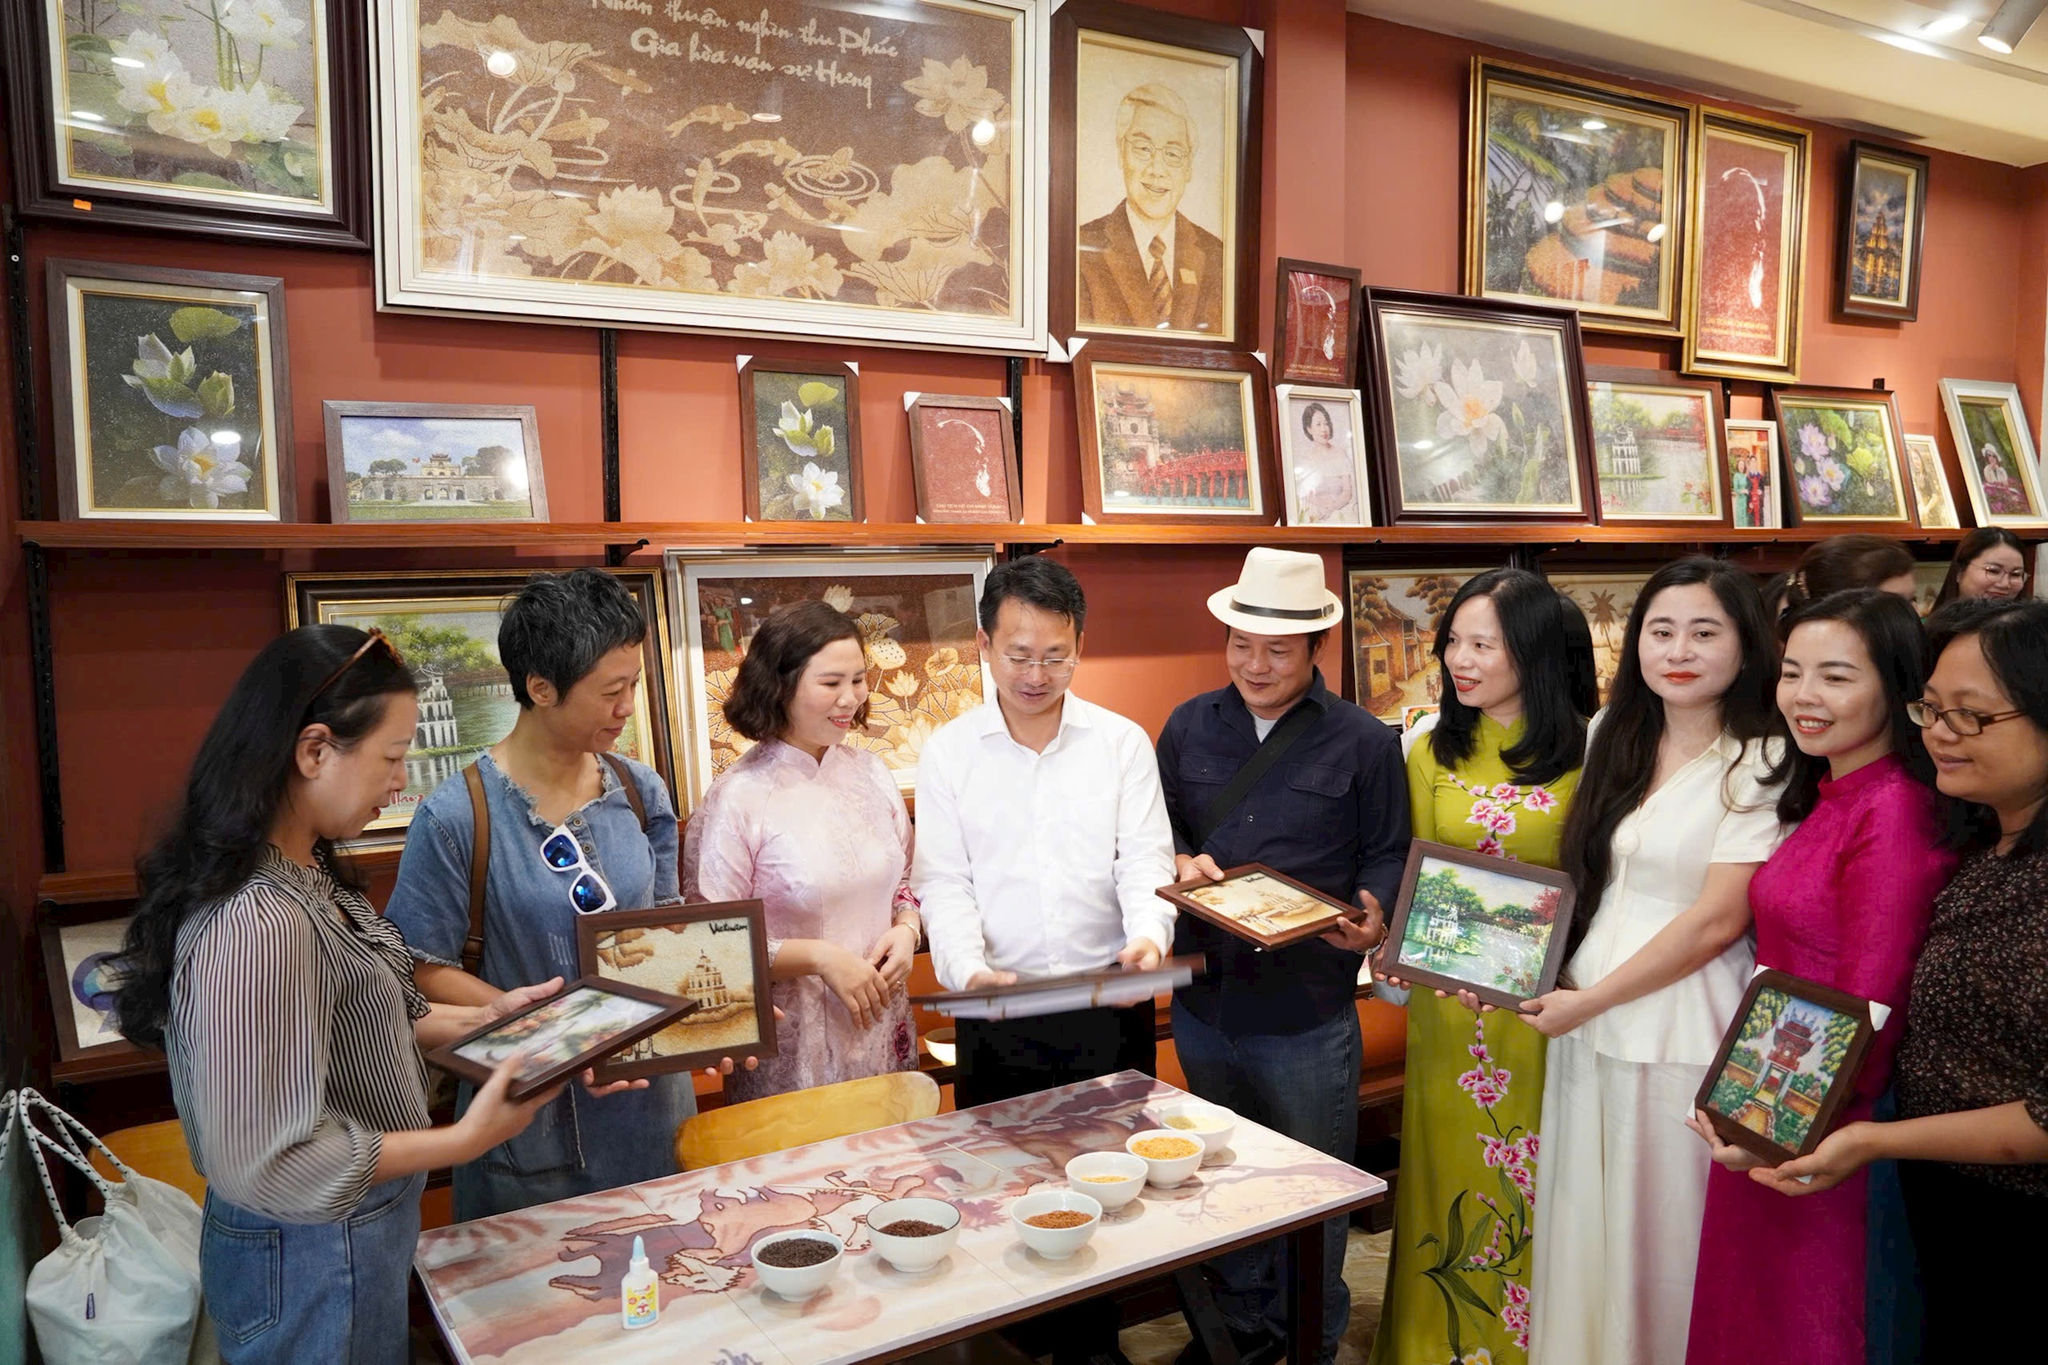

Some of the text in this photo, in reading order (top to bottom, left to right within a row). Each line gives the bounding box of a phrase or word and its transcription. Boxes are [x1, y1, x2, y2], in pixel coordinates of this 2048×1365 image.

[630, 27, 681, 58] Gia
[689, 31, 729, 64] hòa
[732, 54, 775, 74] vạn
[799, 18, 835, 46] thu
